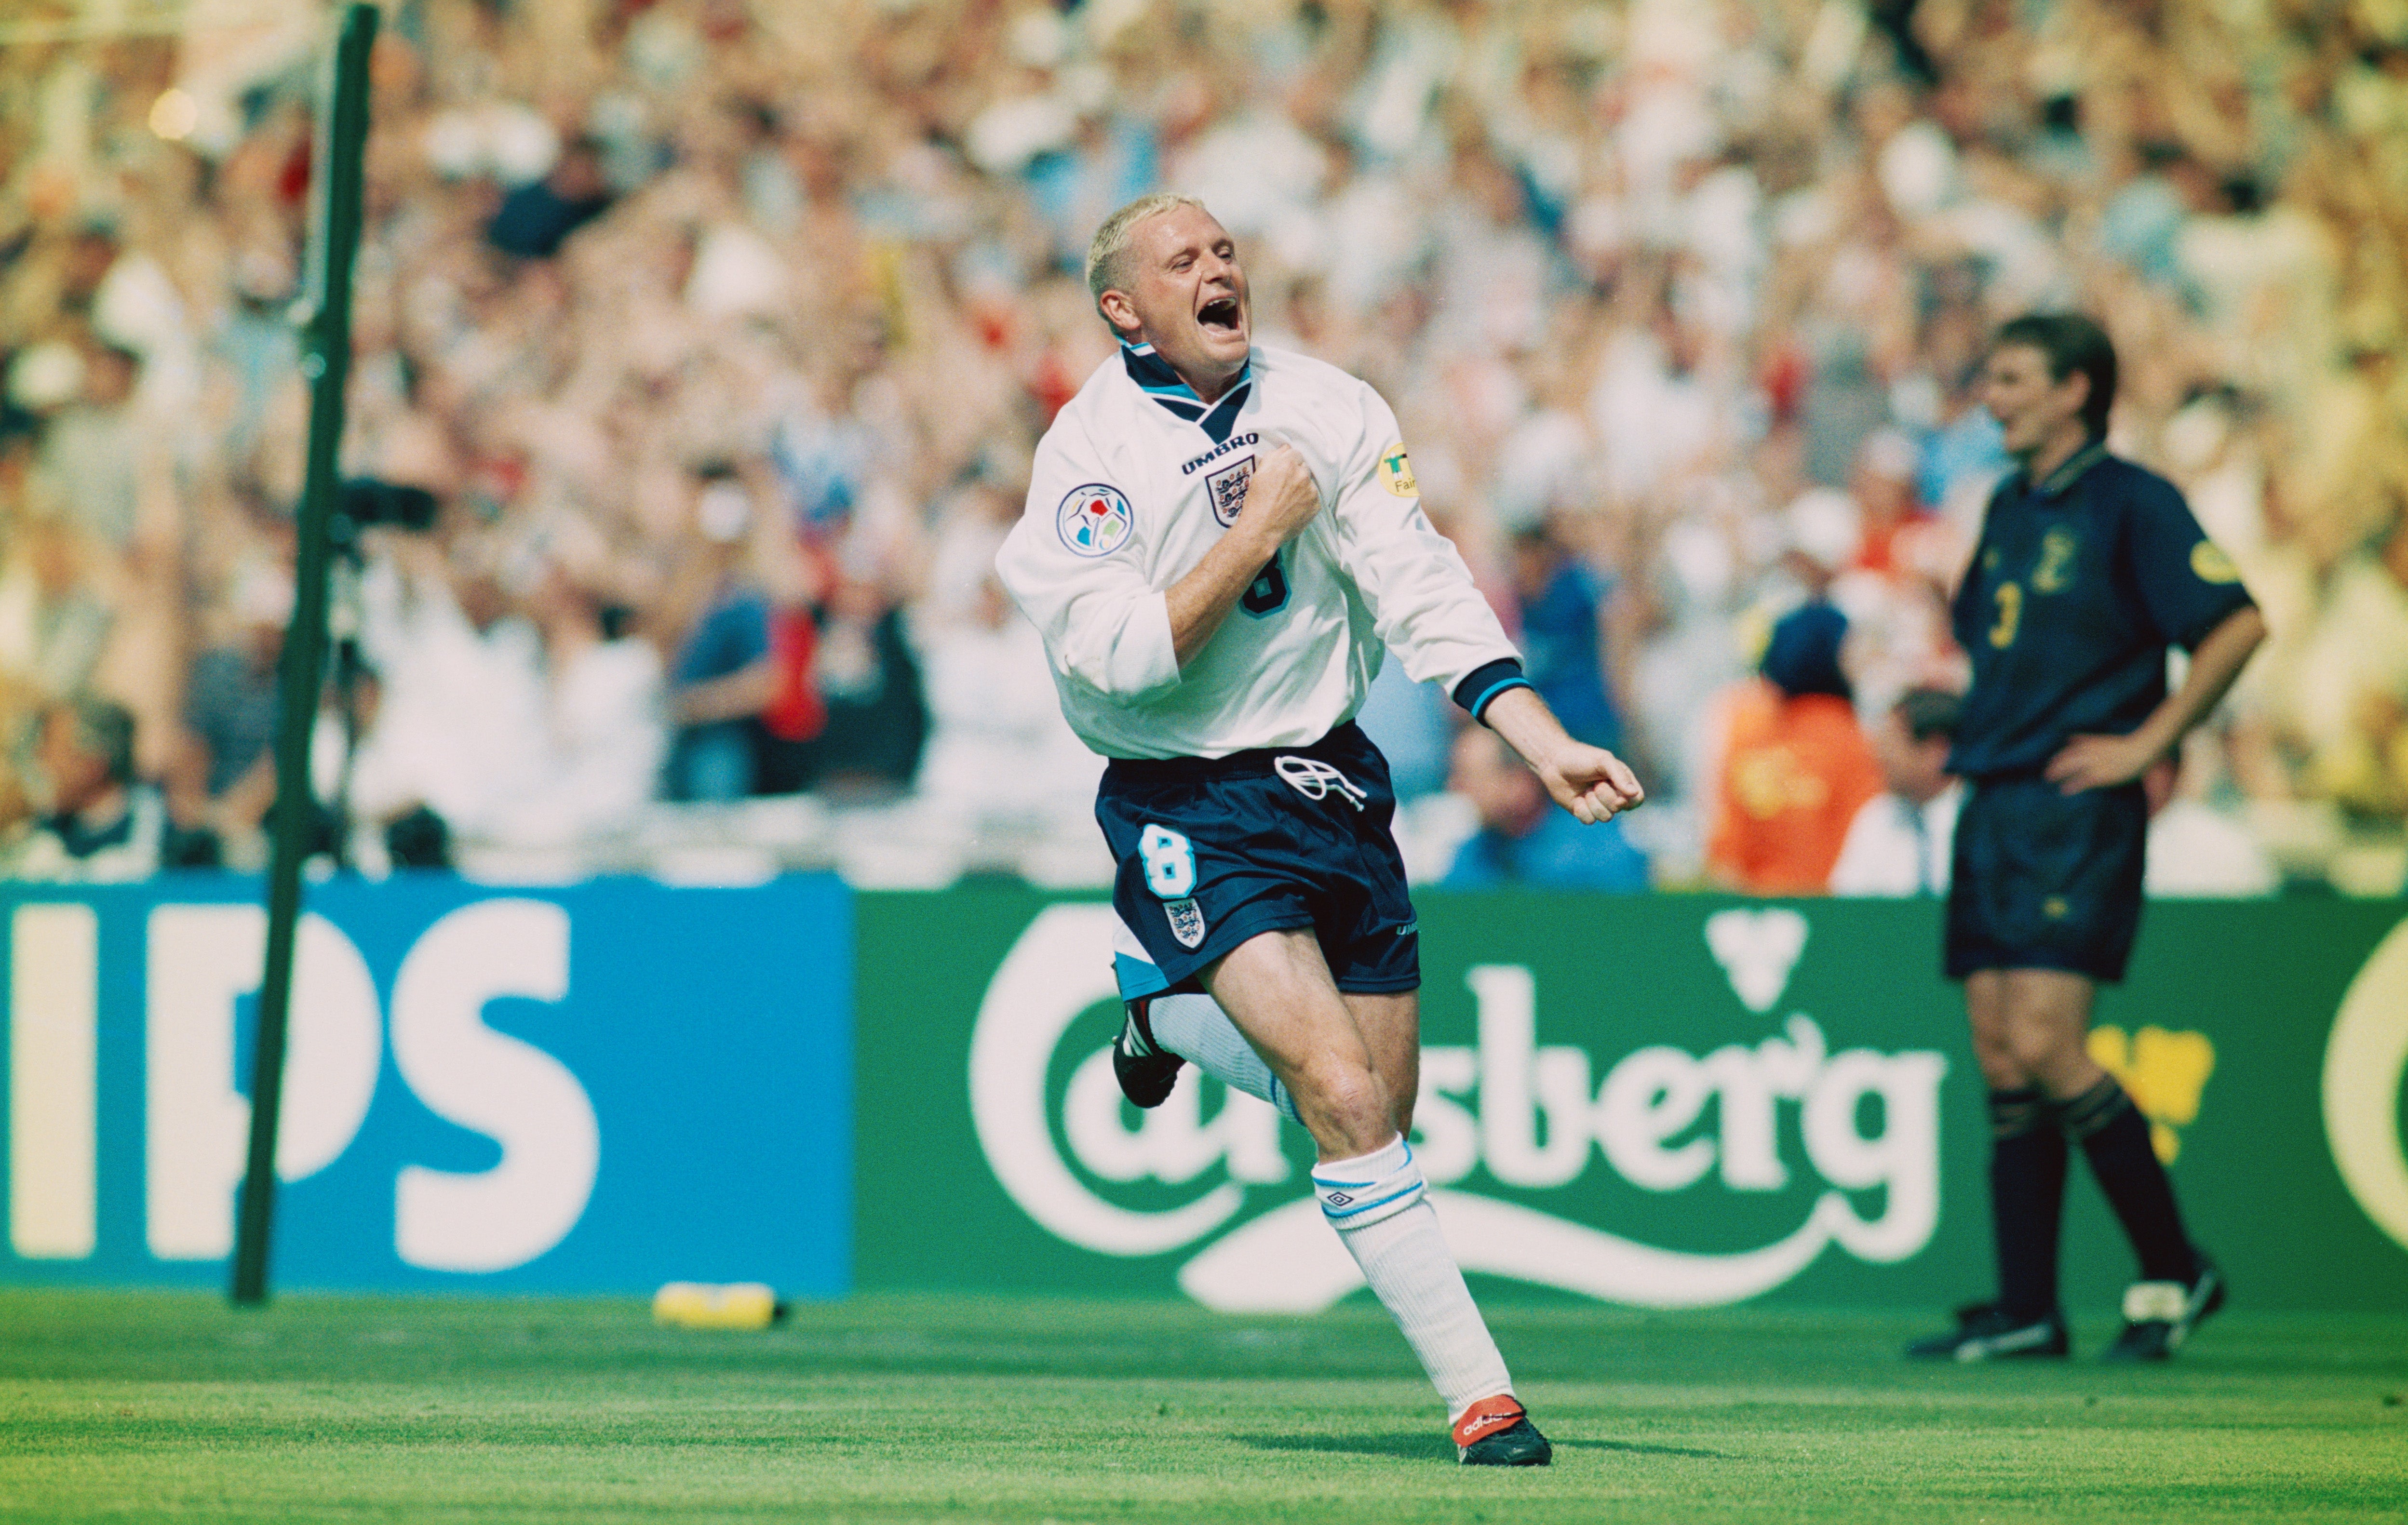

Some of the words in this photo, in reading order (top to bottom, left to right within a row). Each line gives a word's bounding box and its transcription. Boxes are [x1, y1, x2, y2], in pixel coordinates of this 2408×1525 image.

[1182, 432, 1259, 475] UMBRO
[1395, 477, 1415, 492] Fair
[1138, 823, 1197, 899] 8
